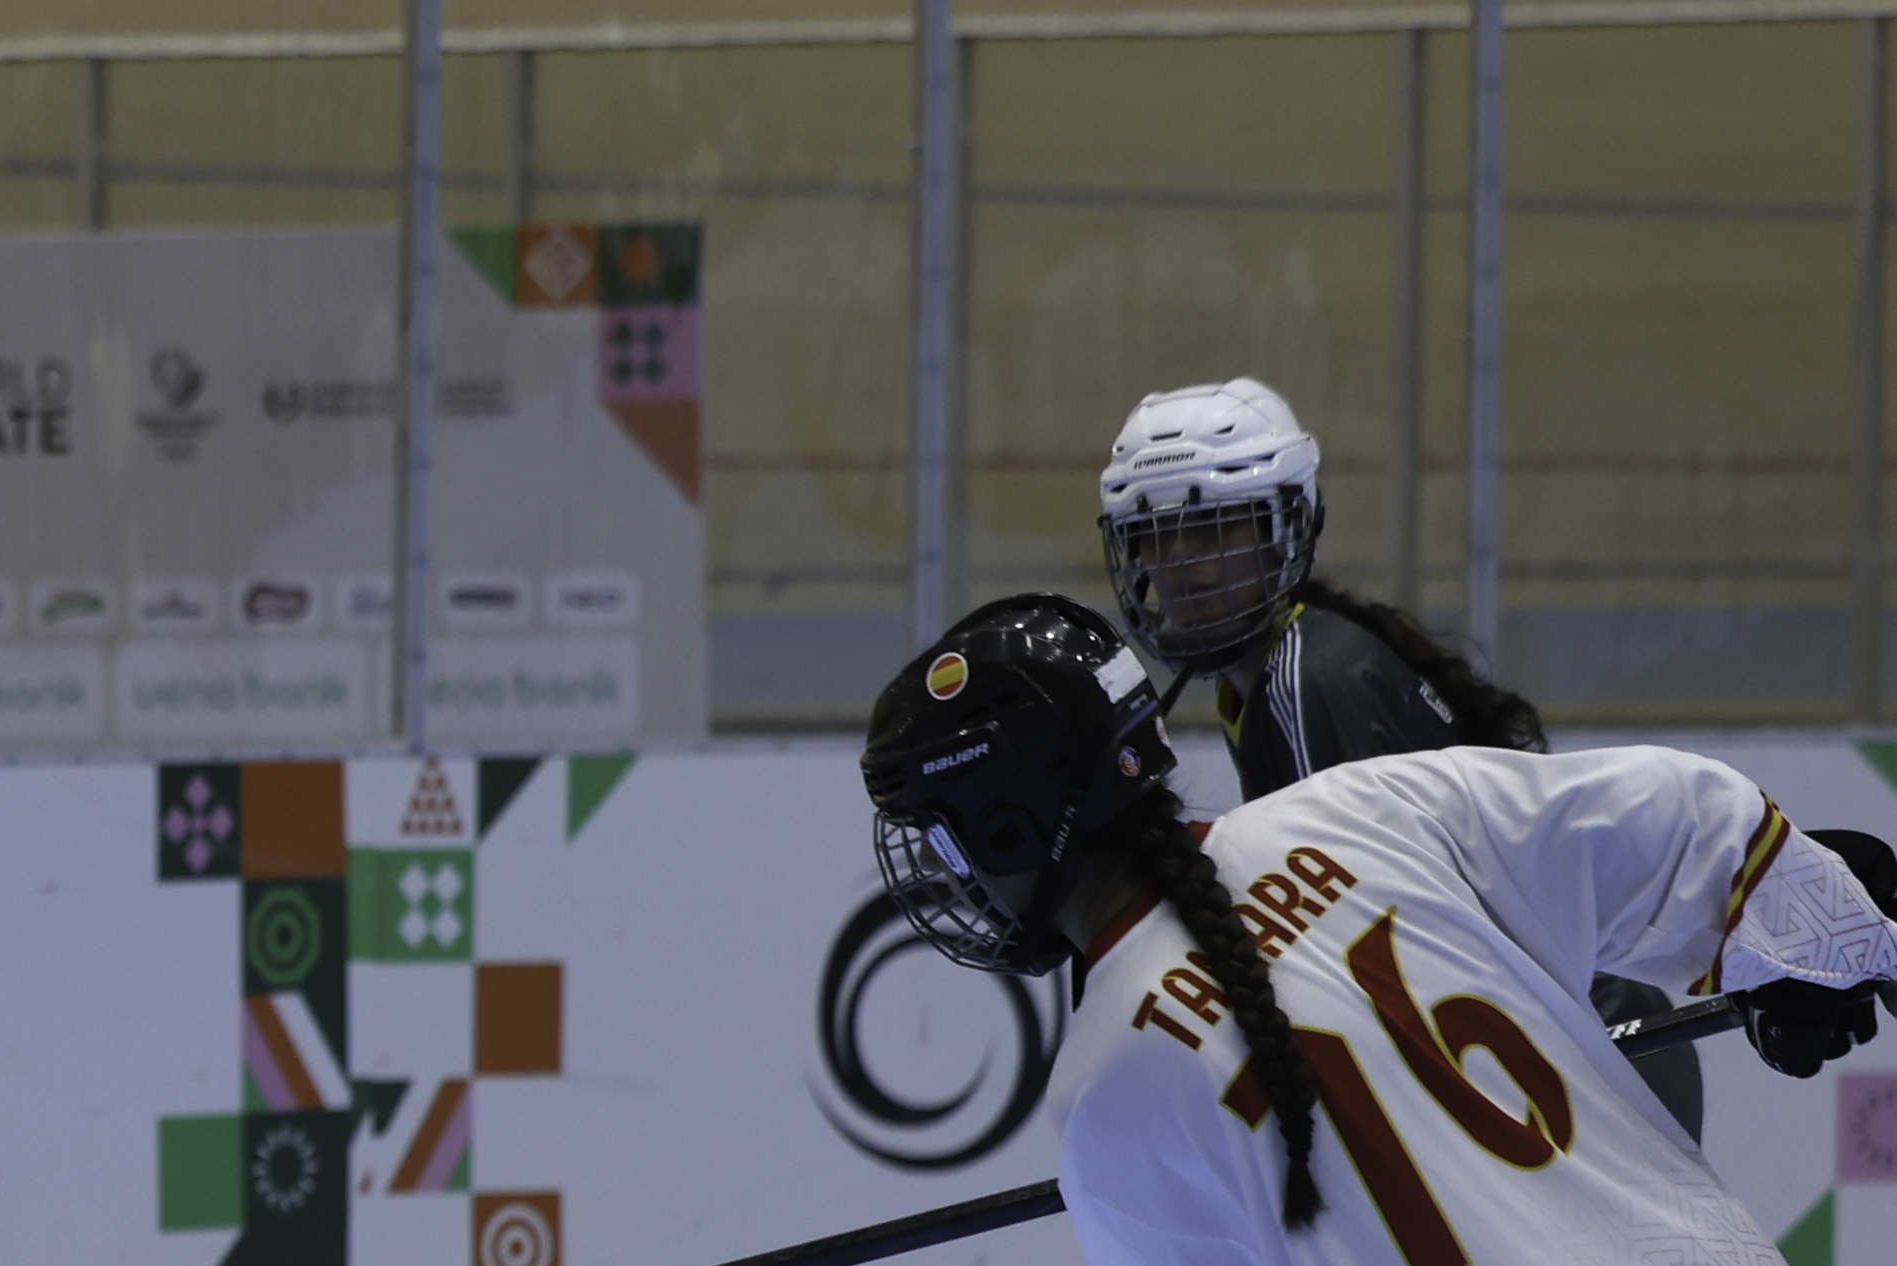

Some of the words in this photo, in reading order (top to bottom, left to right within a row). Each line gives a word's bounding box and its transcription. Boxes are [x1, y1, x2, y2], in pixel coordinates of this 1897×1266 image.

[922, 742, 990, 776] BAUER
[1049, 803, 1077, 864] BAUR
[1132, 847, 1358, 1051] TAARA
